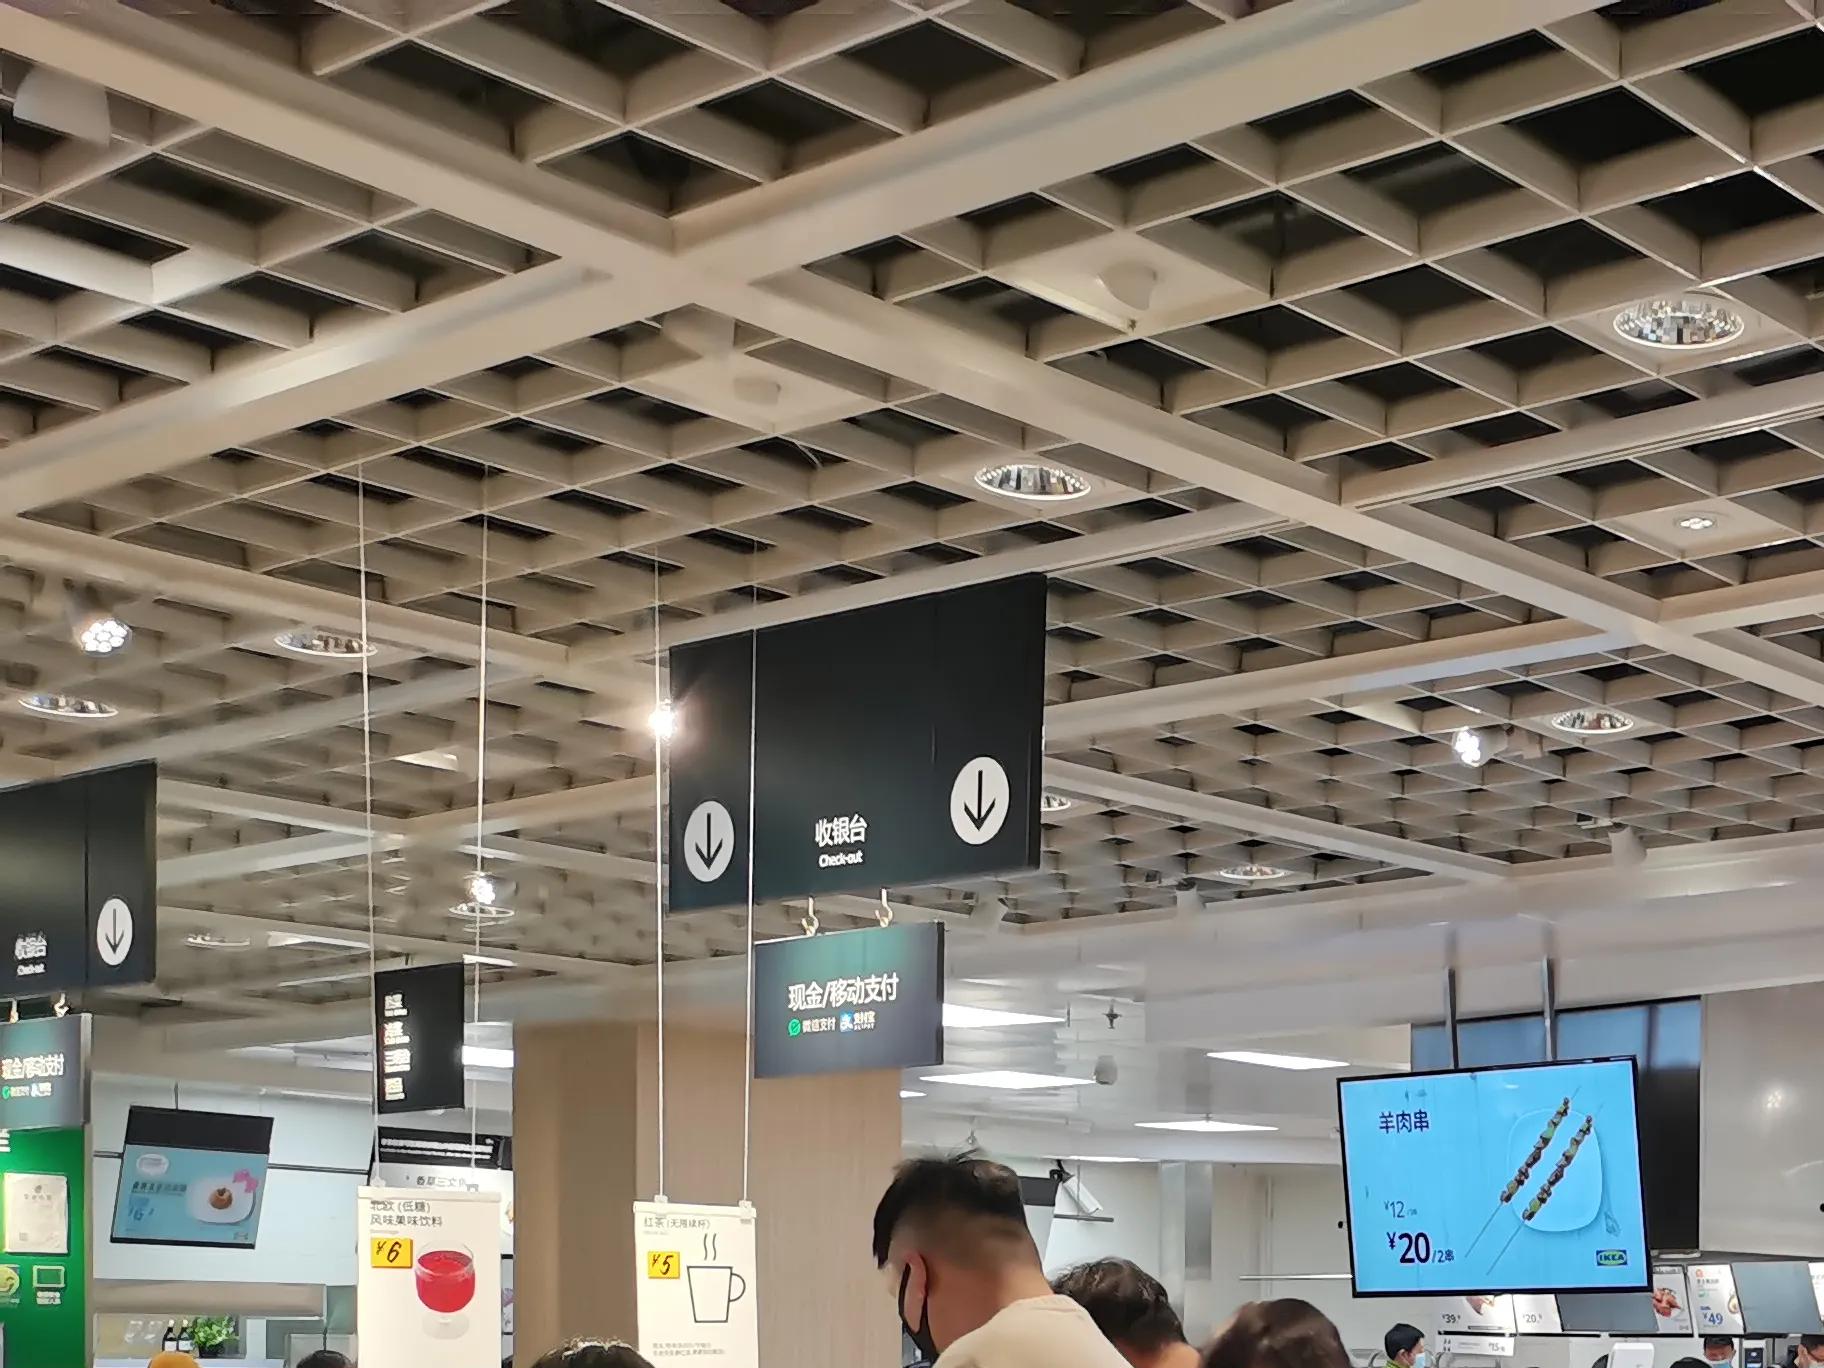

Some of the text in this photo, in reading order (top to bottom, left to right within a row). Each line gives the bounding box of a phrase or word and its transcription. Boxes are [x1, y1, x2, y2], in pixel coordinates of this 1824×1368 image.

[815, 814, 867, 848] 收银台
[819, 850, 864, 868] Check-out
[788, 973, 899, 1011] 现金/移动支付
[1379, 1109, 1430, 1134] 羊肉串
